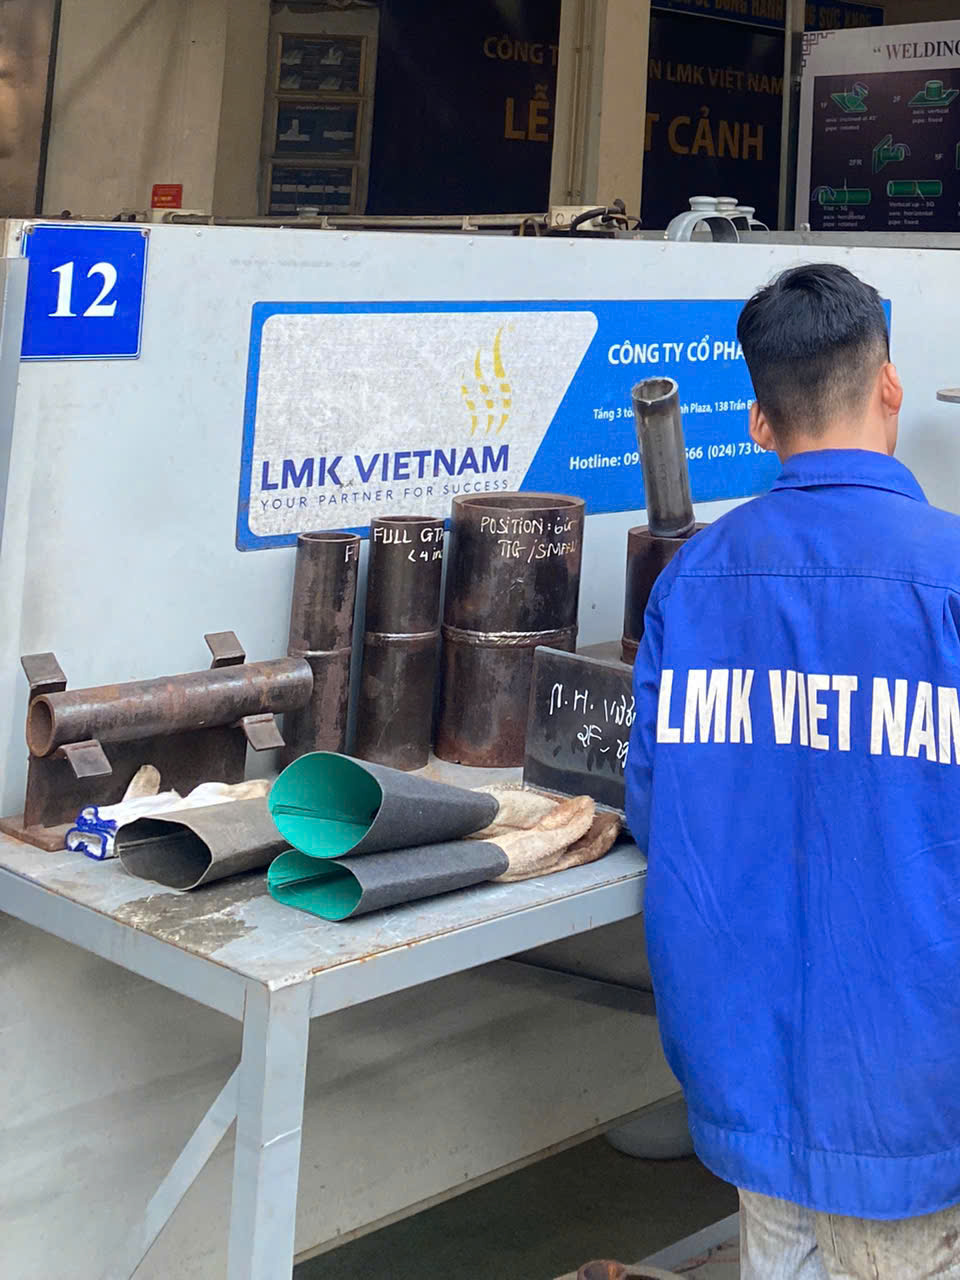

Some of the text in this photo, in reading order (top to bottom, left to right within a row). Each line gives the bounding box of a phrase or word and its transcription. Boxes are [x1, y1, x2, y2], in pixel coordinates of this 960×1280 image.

[483, 34, 544, 64] CÔNG
[667, 61, 704, 86] LMK
[708, 68, 744, 97] VIỆT
[747, 73, 784, 97] NAM
[503, 83, 551, 142] LỄ
[667, 106, 765, 161] CẢNH
[48, 261, 118, 318] 12
[607, 341, 660, 365] CÔNG
[664, 344, 684, 364] TY
[686, 334, 711, 362] CỔ
[616, 408, 622, 419] 3
[690, 402, 713, 415] Plaza,
[714, 400, 729, 412] 138
[260, 444, 509, 492] LMK VIETNAM
[569, 455, 621, 470] Hotline:
[623, 453, 641, 467] 09
[708, 443, 737, 461] (024)
[738, 442, 752, 456] 73
[260, 479, 509, 511] YOUR PARTNER FOR SUCCESS
[373, 527, 413, 545] FULL
[656, 669, 755, 744] LMK
[768, 669, 858, 751] VIET
